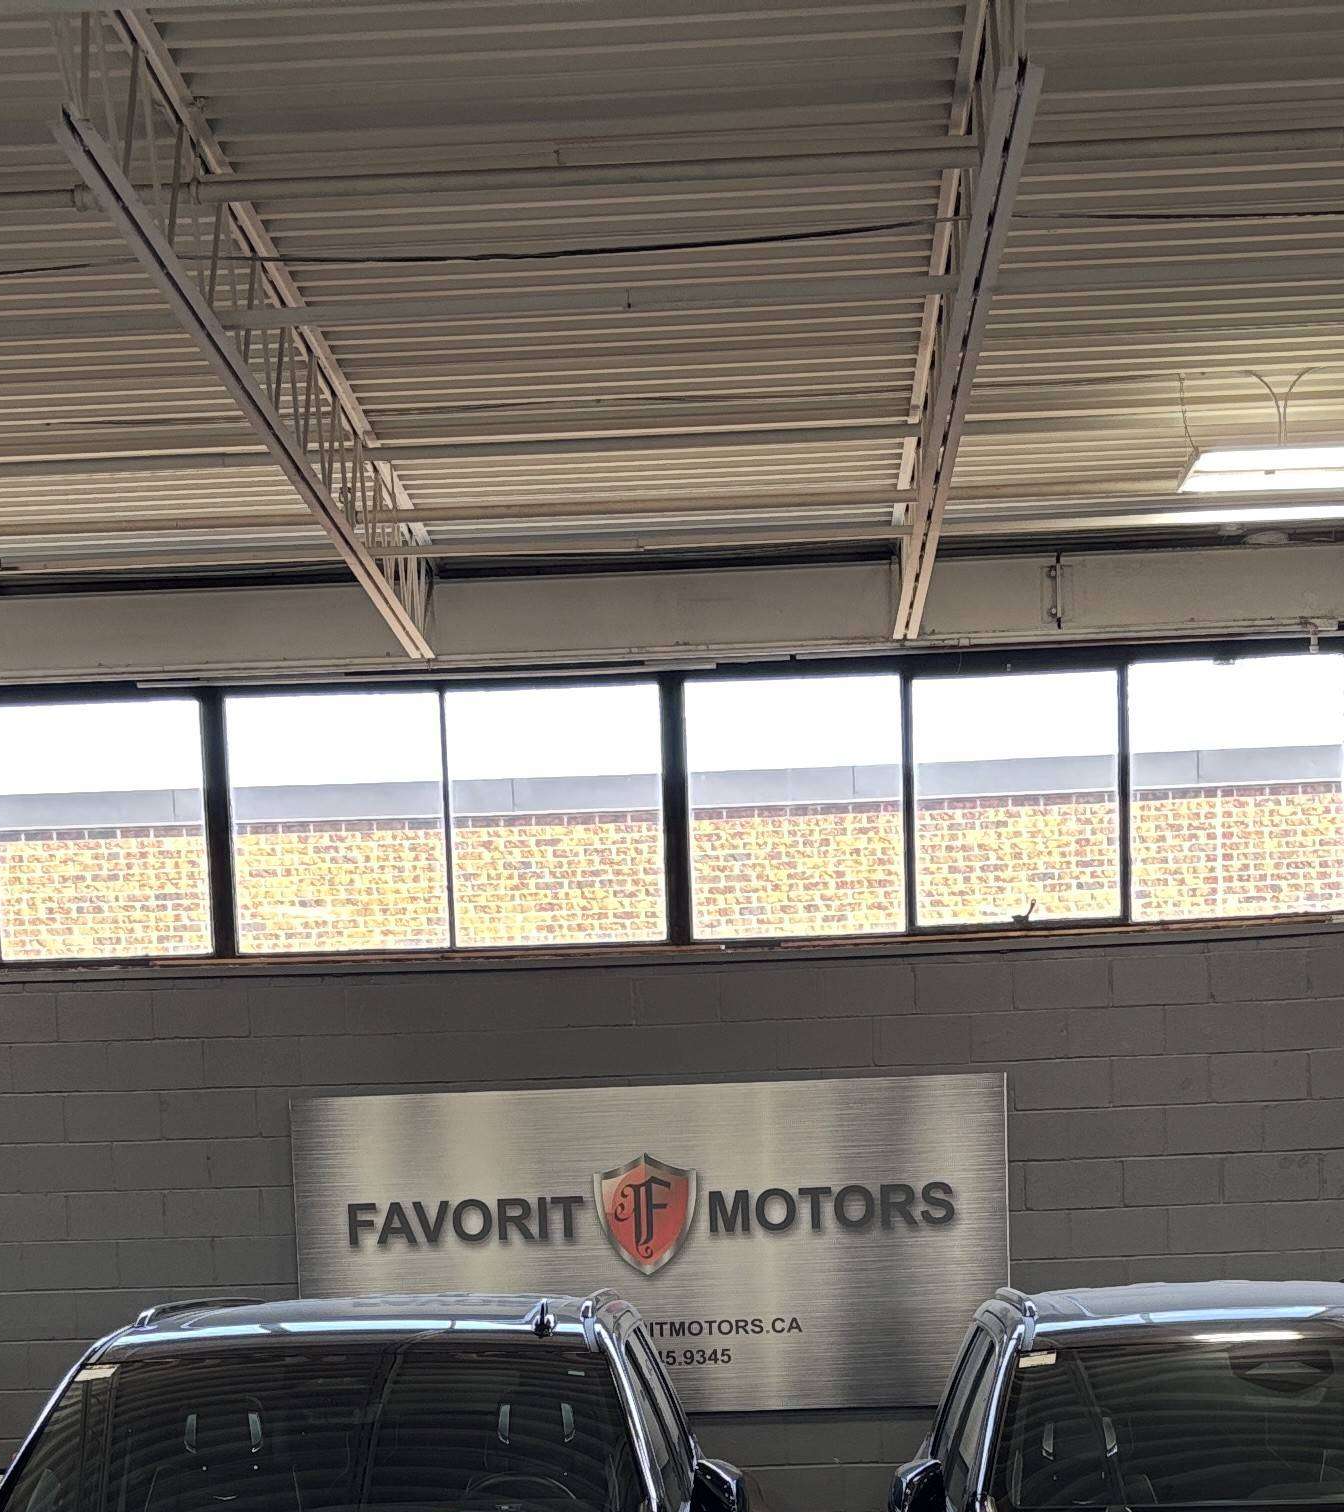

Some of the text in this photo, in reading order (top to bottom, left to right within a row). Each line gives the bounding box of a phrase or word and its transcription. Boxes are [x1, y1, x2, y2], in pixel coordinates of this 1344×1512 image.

[347, 1196, 584, 1245] FAVORIT
[708, 1181, 955, 1233] MOTORS
[644, 1317, 803, 1338] ITMOTORS.CA
